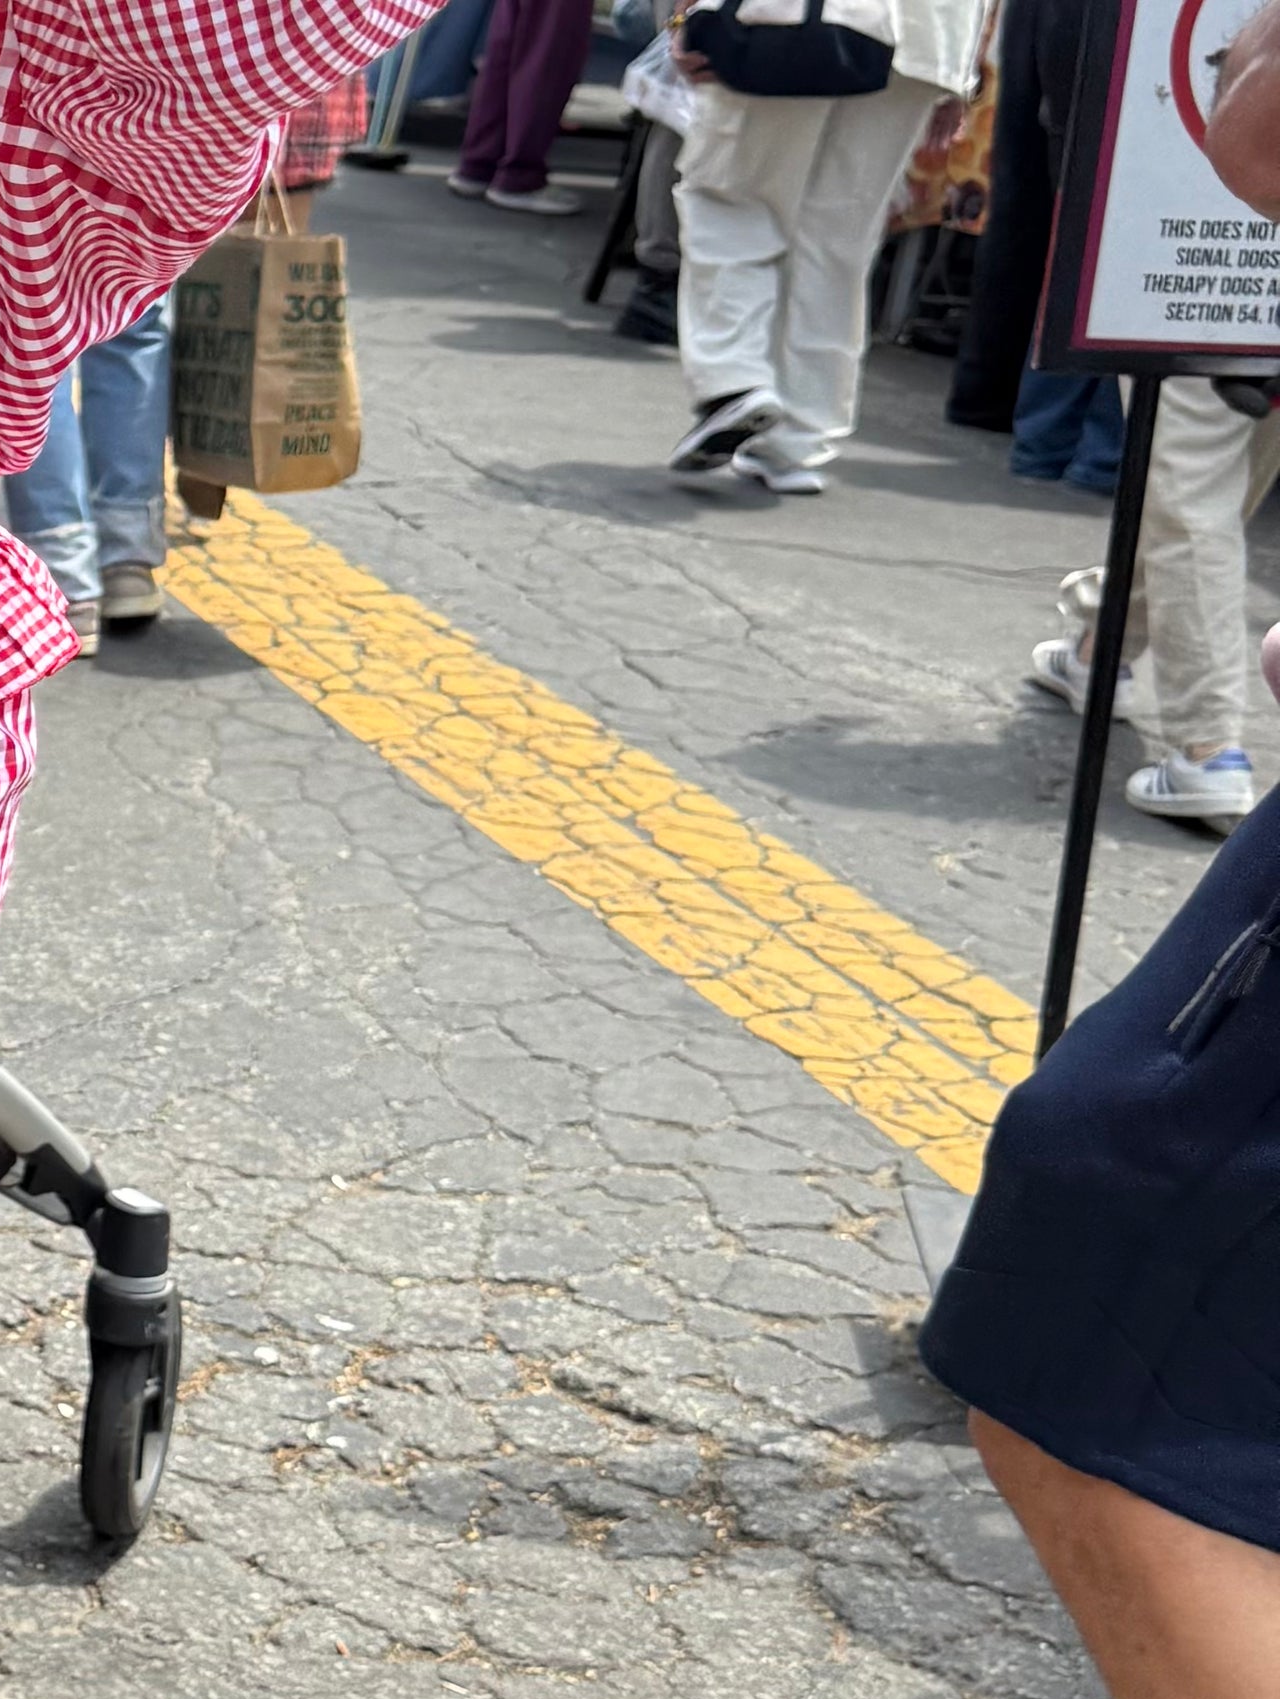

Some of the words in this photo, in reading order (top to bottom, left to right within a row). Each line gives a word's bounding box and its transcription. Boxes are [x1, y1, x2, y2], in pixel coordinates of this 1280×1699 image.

[1160, 218, 1196, 238] THIS
[1200, 219, 1243, 240] DOES
[1246, 220, 1278, 241] NOT
[1176, 247, 1232, 267] SIGNAL
[1237, 248, 1280, 269] DOGS
[1143, 273, 1217, 295] THERAPY
[1220, 275, 1264, 296] DOGS
[1165, 302, 1233, 321] SECTION
[282, 433, 332, 456] MIND
